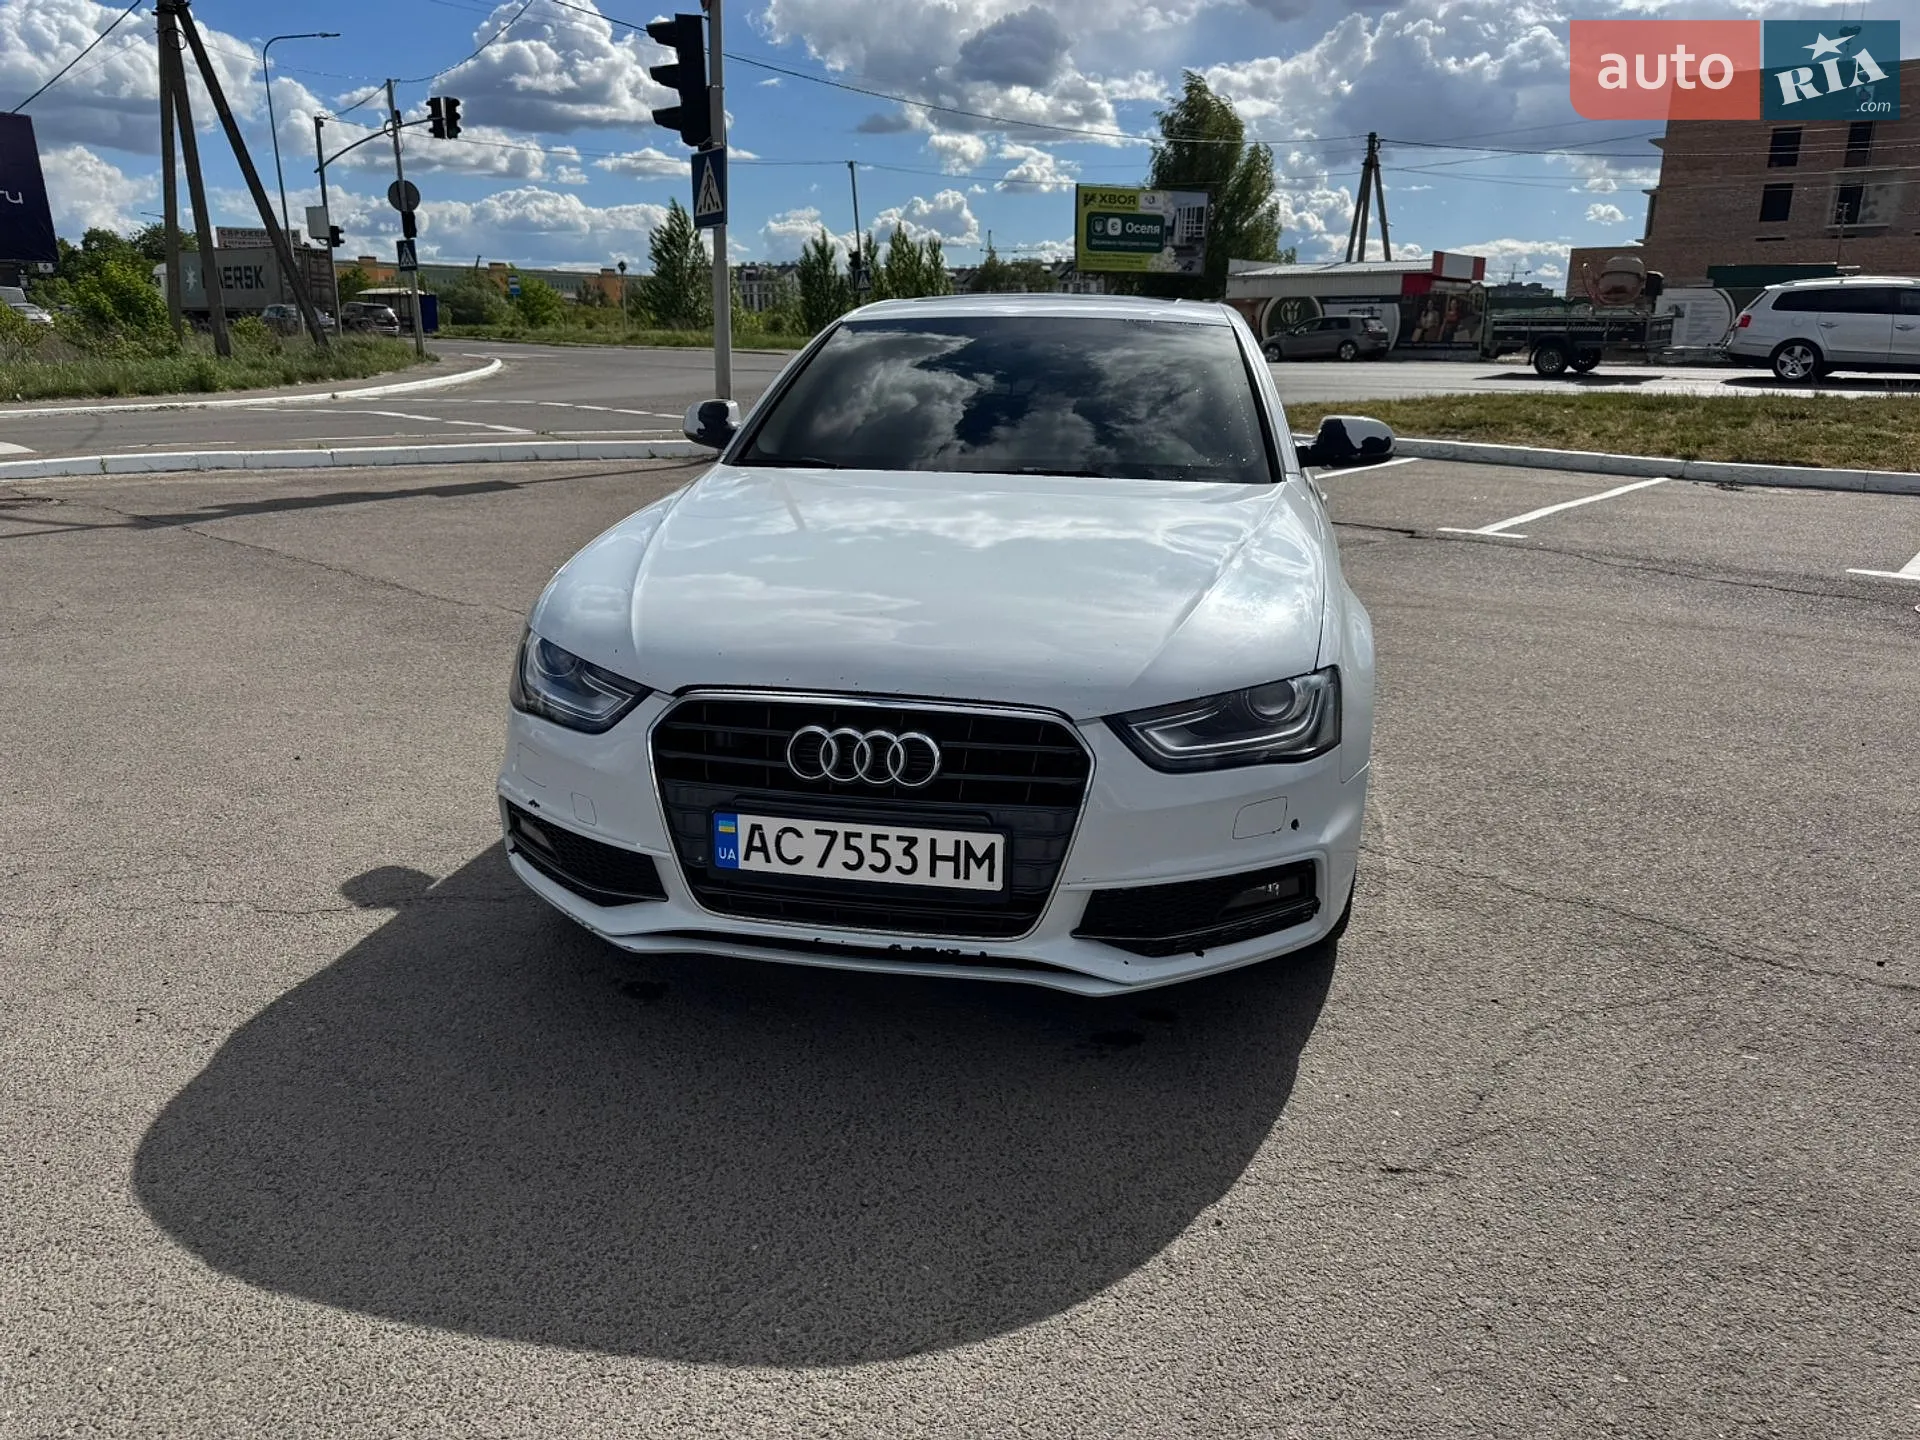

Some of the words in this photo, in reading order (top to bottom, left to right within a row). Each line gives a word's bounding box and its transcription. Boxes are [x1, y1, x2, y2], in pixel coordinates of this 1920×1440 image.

[1125, 222, 1161, 235] Оселя
[201, 265, 265, 289] ERSK
[718, 847, 736, 861] UA
